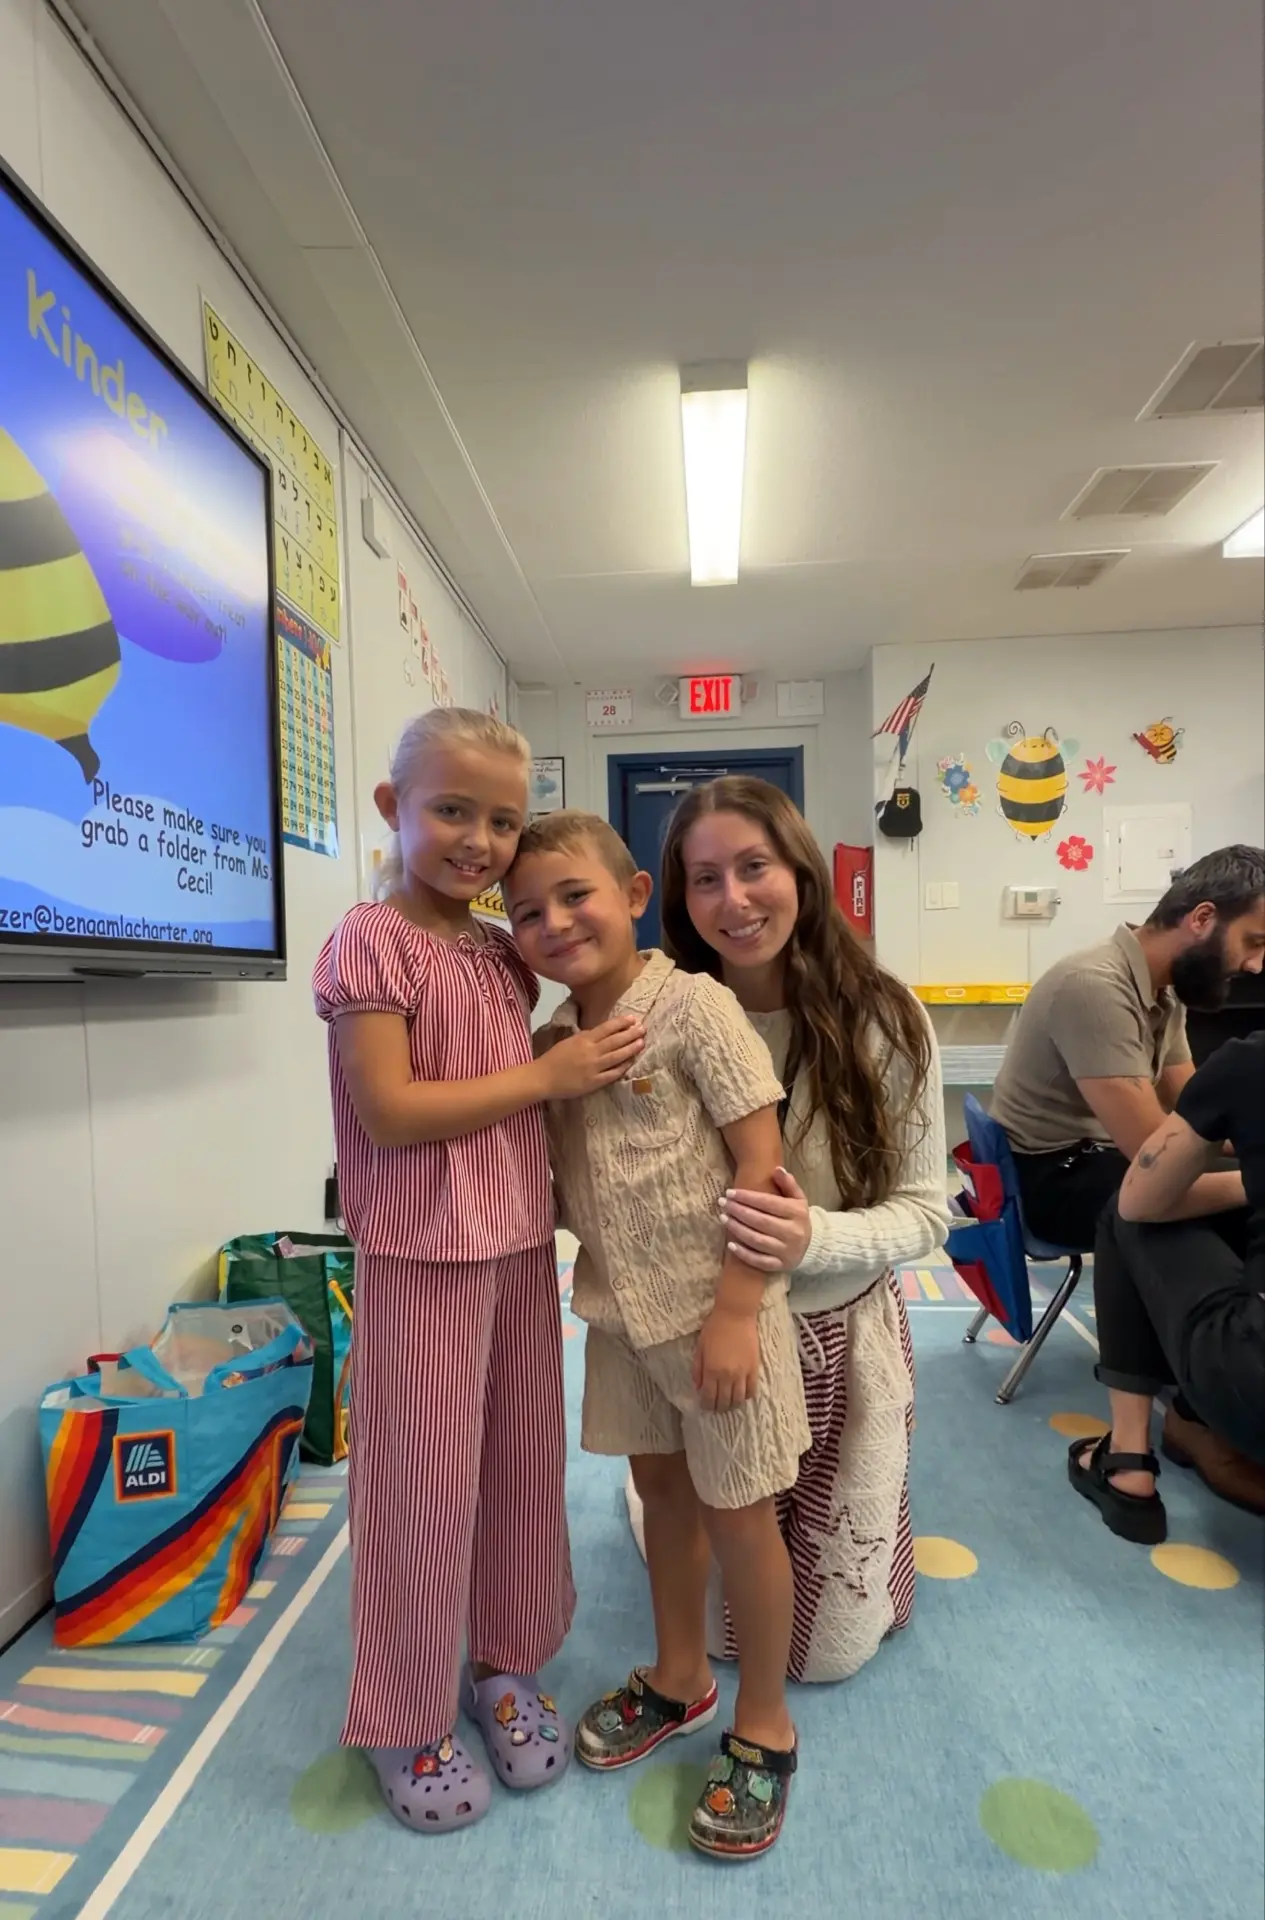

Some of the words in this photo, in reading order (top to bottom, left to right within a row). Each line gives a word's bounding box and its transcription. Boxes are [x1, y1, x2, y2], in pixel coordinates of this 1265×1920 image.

[26, 268, 169, 448] Kinder
[602, 705, 616, 716] 28
[689, 677, 733, 714] EXIT
[93, 778, 154, 822] Please
[163, 806, 204, 836] make
[211, 822, 240, 846] sure
[245, 833, 266, 856] you
[82, 818, 128, 847] grab
[138, 832, 149, 852] a
[158, 830, 207, 866] folder
[213, 845, 246, 875] from
[251, 856, 273, 881] Ms.
[177, 867, 213, 895] Ceci!
[856, 881, 864, 915] FIRE
[125, 1471, 166, 1488] ALDI
